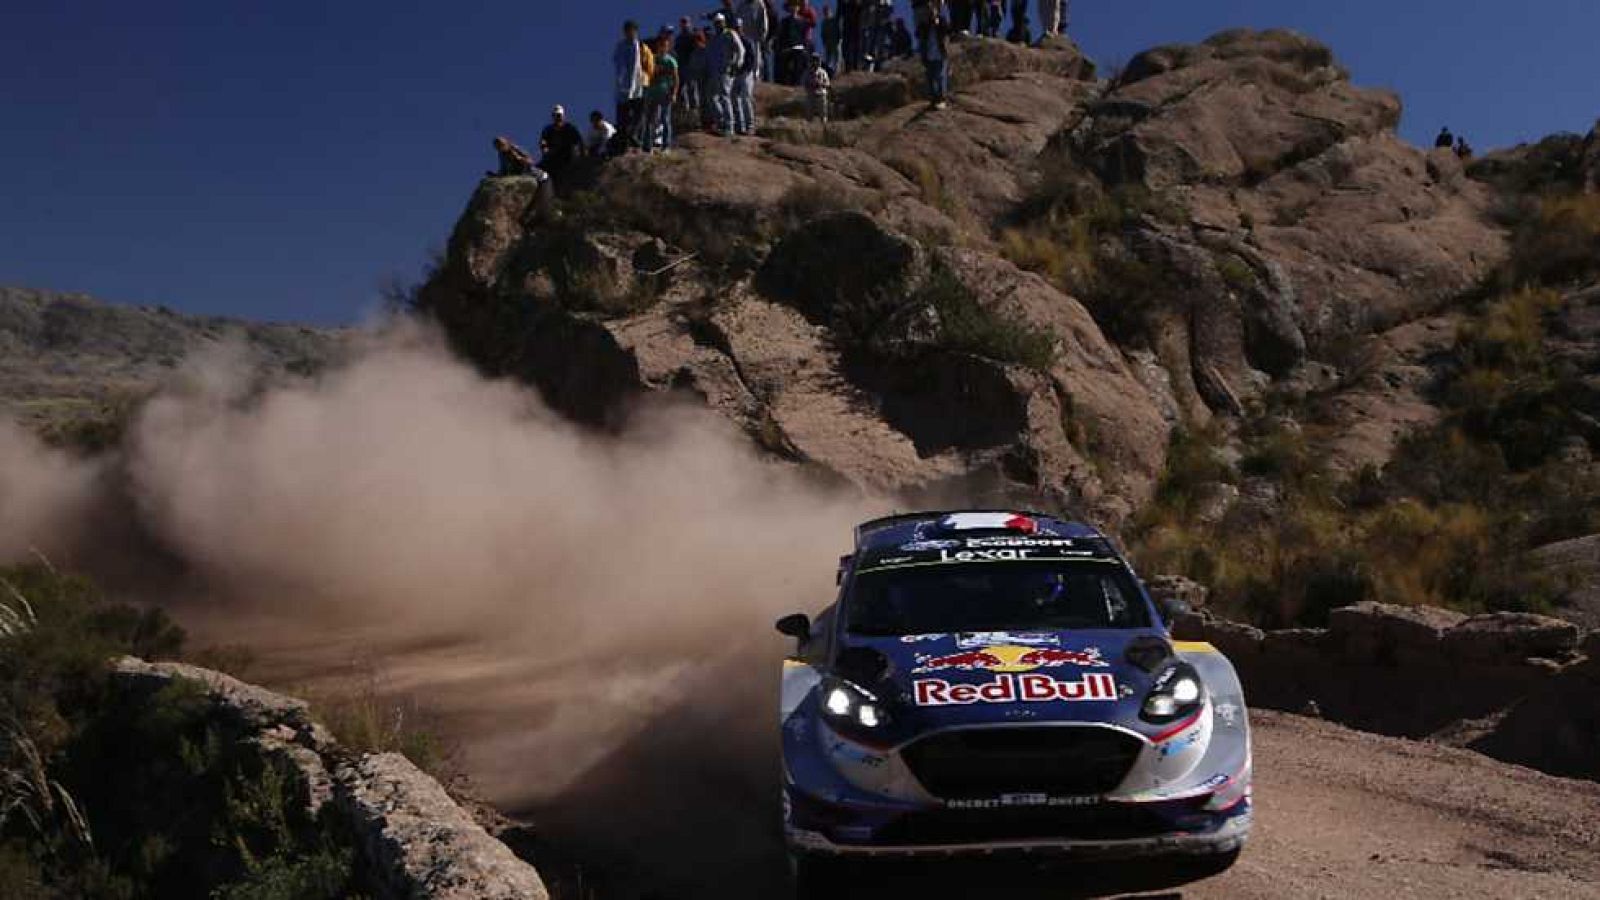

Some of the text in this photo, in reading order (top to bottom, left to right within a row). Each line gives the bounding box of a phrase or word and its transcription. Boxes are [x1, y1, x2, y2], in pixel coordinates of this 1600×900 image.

[940, 549, 1033, 563] Lexar
[914, 673, 1016, 706] Red
[1018, 673, 1118, 701] Bull
